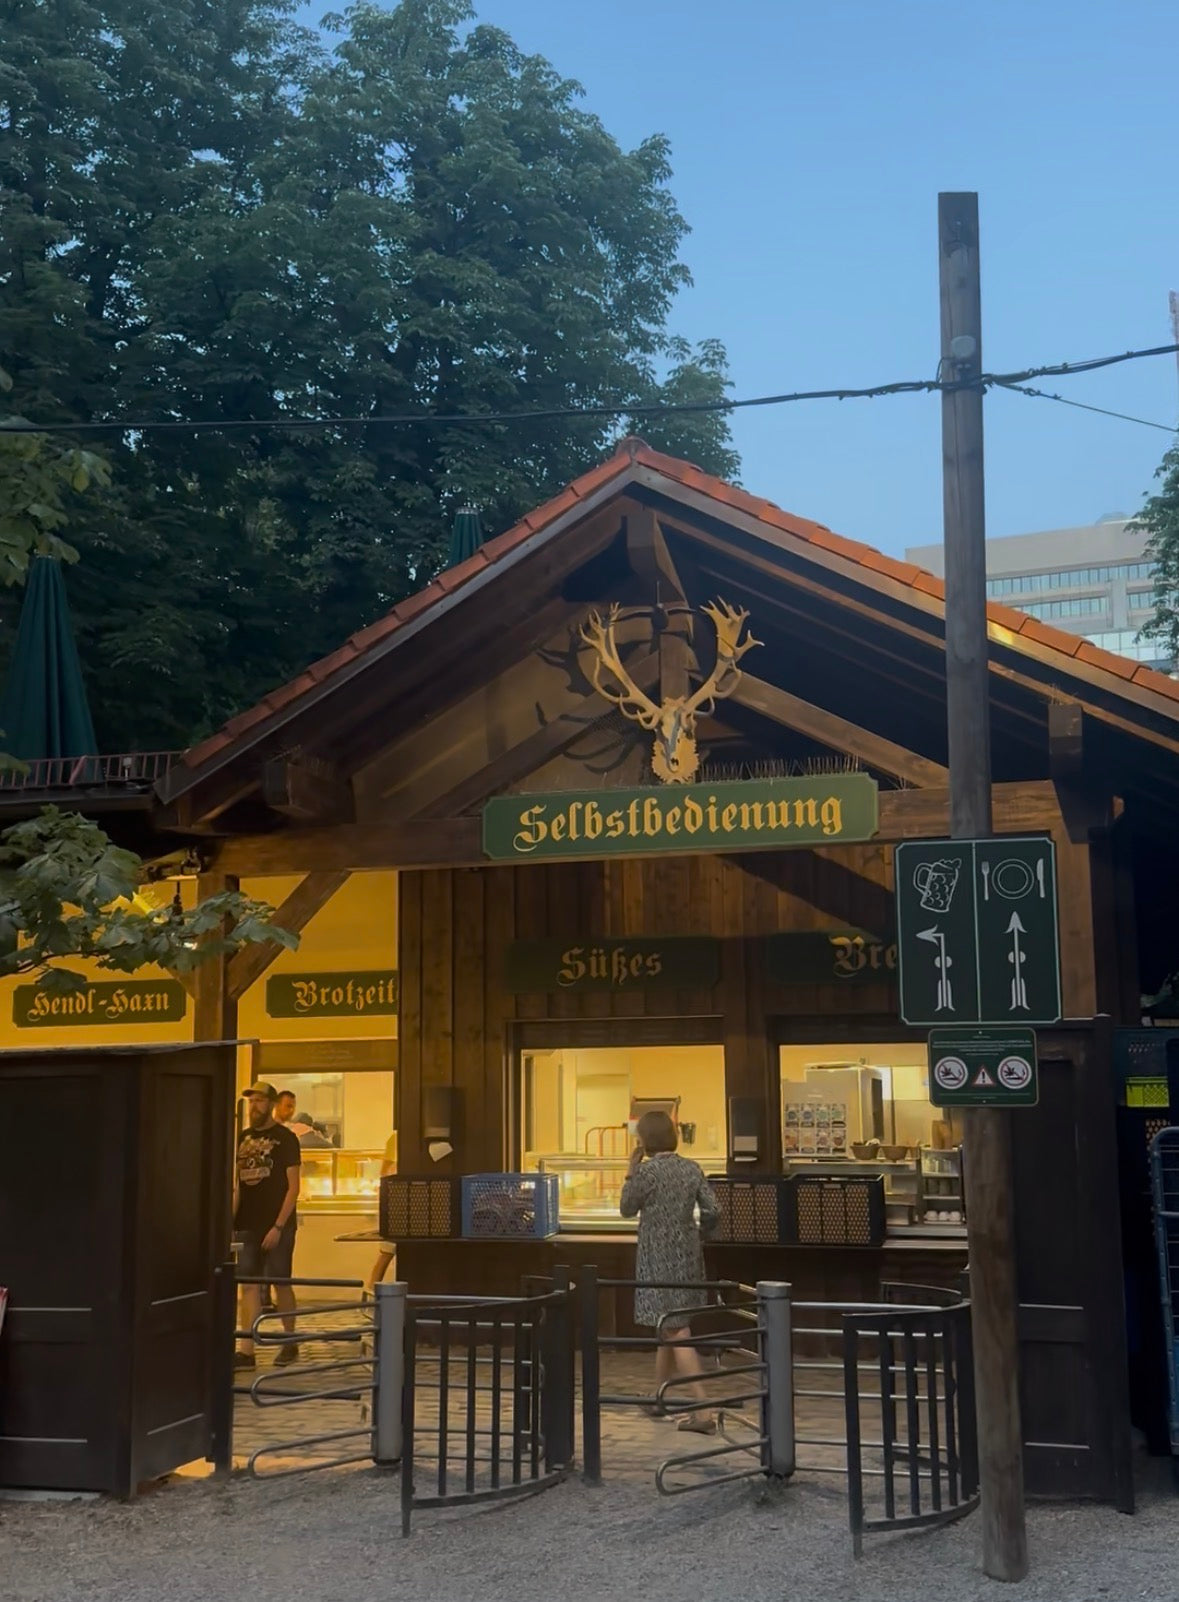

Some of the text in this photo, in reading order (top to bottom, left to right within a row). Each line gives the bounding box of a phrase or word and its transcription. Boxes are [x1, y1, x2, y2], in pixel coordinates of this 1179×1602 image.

[512, 793, 843, 852] Selbstbedienung
[556, 947, 663, 986] Süßes
[291, 978, 397, 1012] Brotzeit
